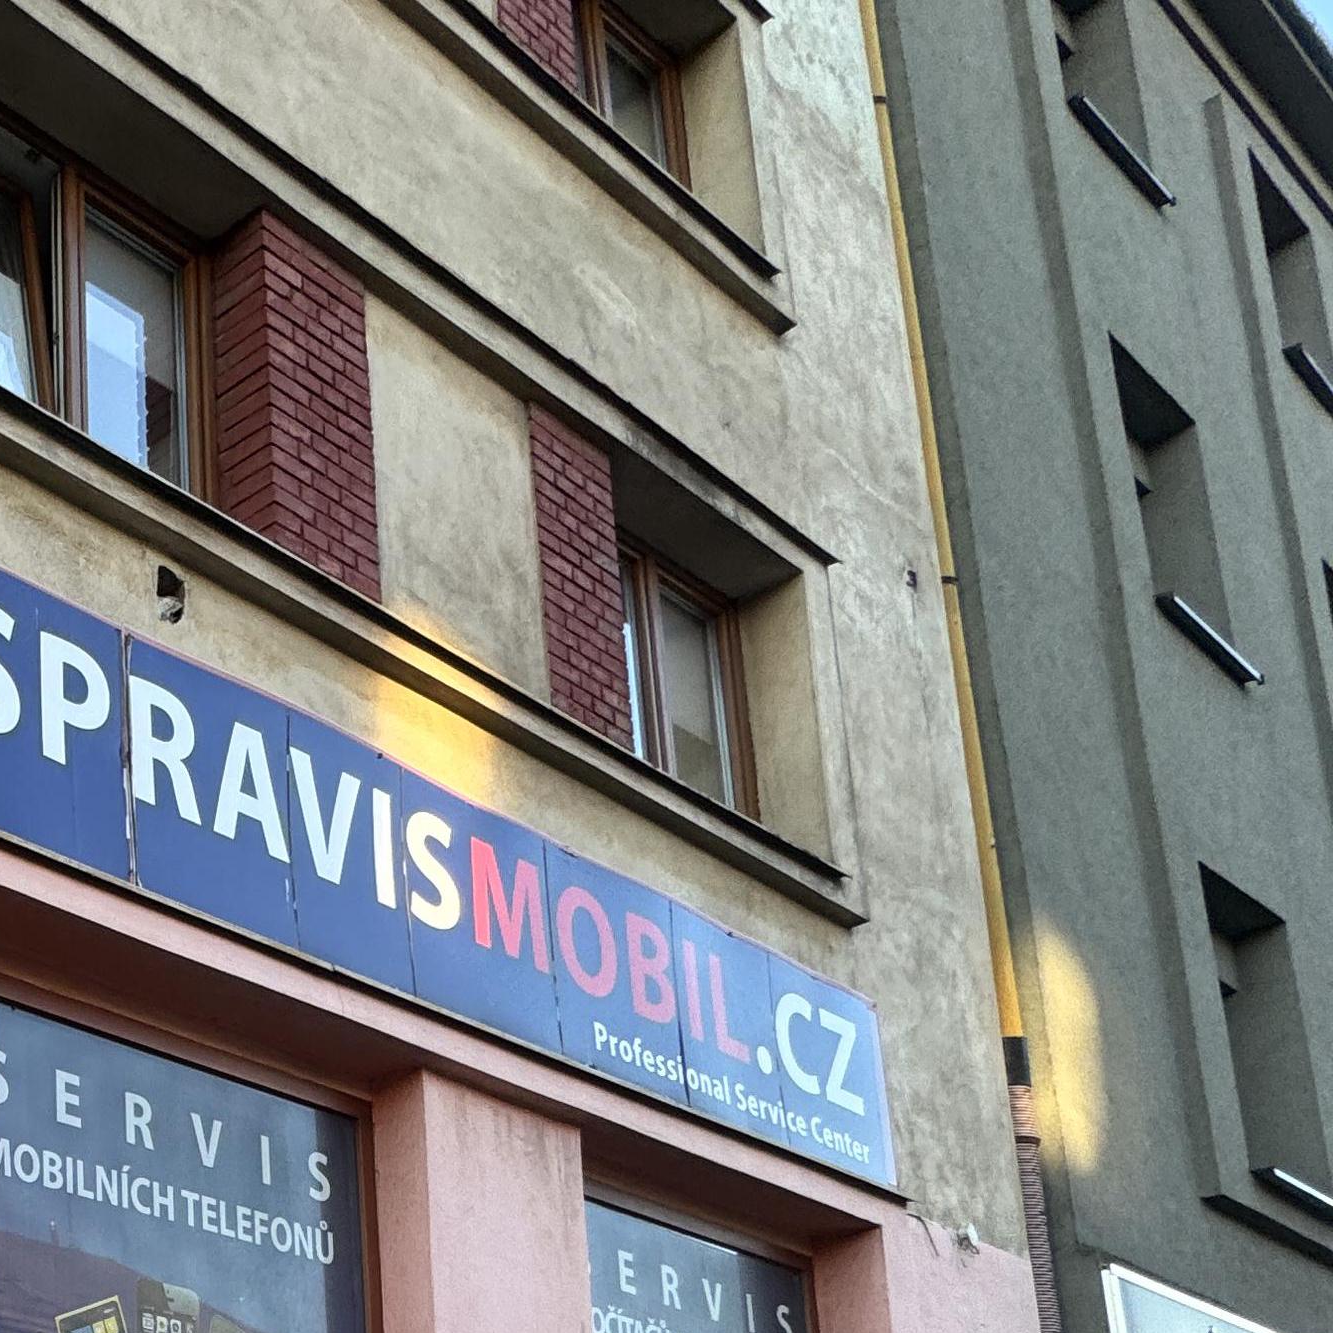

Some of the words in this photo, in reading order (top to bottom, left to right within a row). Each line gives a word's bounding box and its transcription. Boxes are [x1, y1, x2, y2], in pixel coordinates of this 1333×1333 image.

[593, 1021, 731, 1105] Professional
[735, 1085, 808, 1136] Service
[810, 1118, 870, 1164] Center
[180, 1188, 334, 1265] TELEFONŮ
